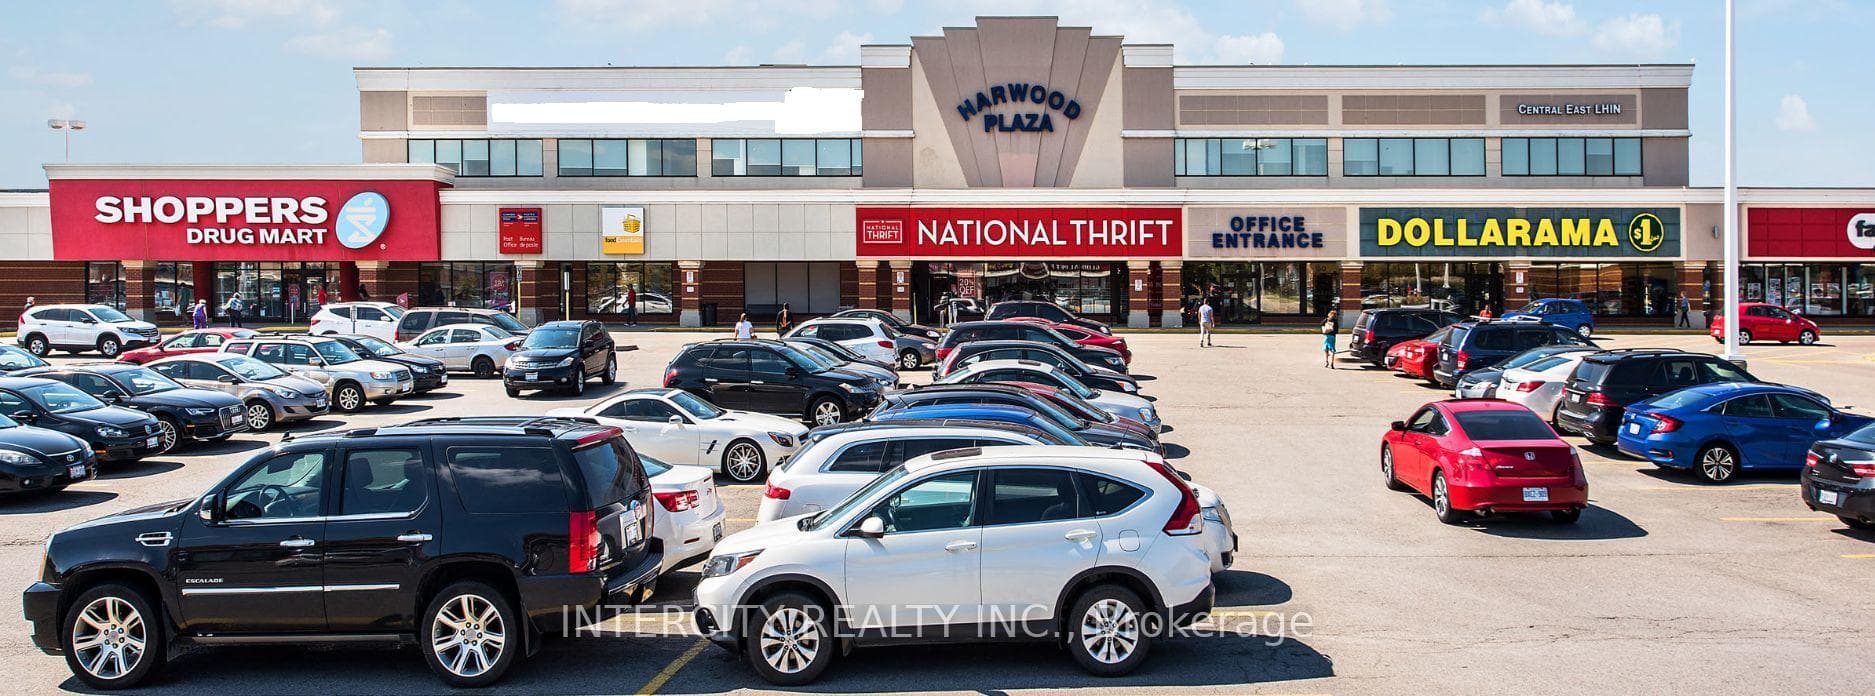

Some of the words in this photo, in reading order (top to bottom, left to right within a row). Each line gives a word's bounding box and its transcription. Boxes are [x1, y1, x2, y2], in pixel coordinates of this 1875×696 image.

[957, 83, 1081, 122] HARWOOD
[1595, 104, 1621, 114] LHIN
[984, 113, 1054, 133] PLAZA
[95, 196, 328, 224] SHOPPERS
[918, 219, 1067, 246] NATIONAL
[1070, 219, 1174, 246] THRIFT
[1230, 216, 1305, 232] OFFICE
[1377, 218, 1619, 247] DOLLARAMA
[186, 228, 254, 244] DRUG
[259, 228, 328, 244] MART
[867, 230, 899, 240] THRIFT
[1212, 232, 1324, 249] ENTRANCE
[959, 286, 974, 295] OFF
